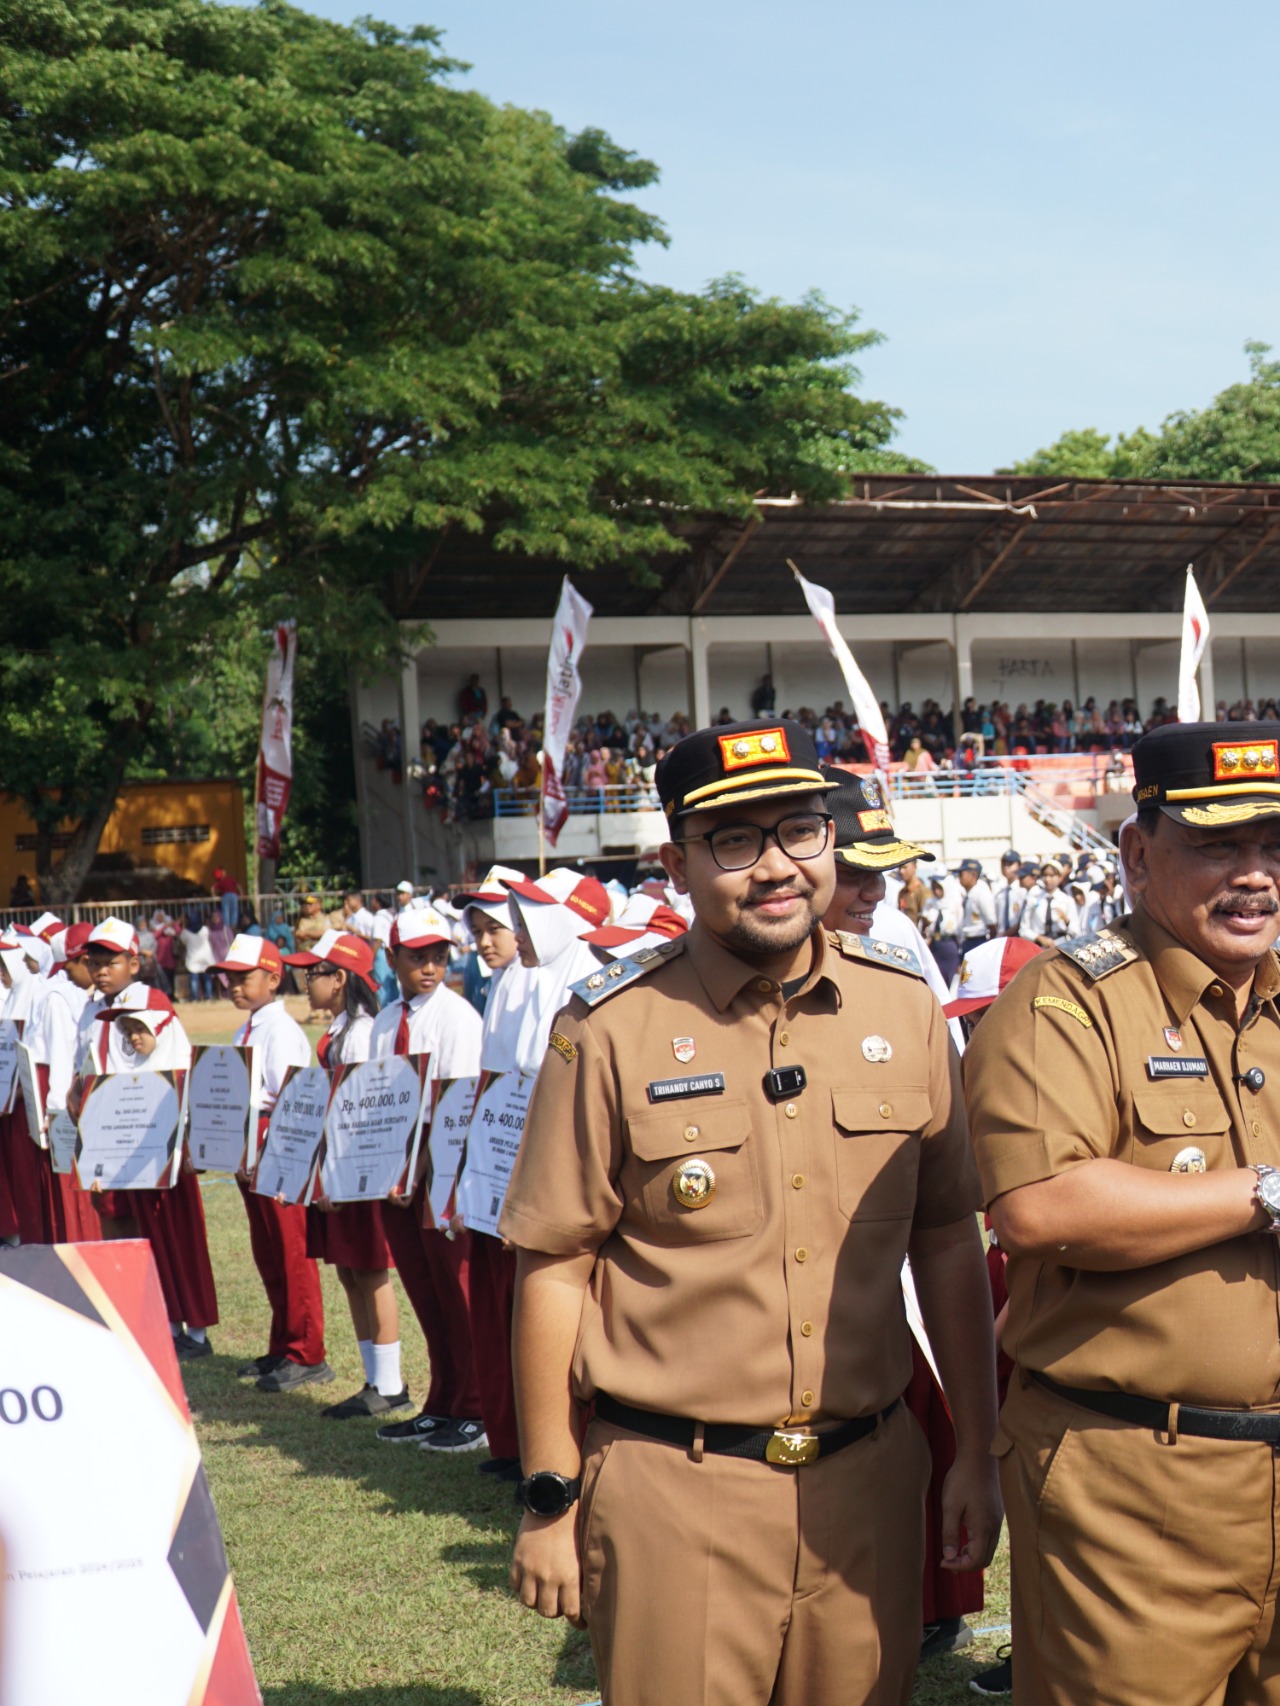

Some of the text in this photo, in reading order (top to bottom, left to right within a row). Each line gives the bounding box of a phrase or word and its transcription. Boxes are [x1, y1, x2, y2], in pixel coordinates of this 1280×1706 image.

[1153, 1060, 1181, 1071] MARHAEN
[654, 1078, 721, 1096] TRIHANDY CAHYO S
[444, 1115, 457, 1131] Rp.
[483, 1108, 496, 1126] Rp.
